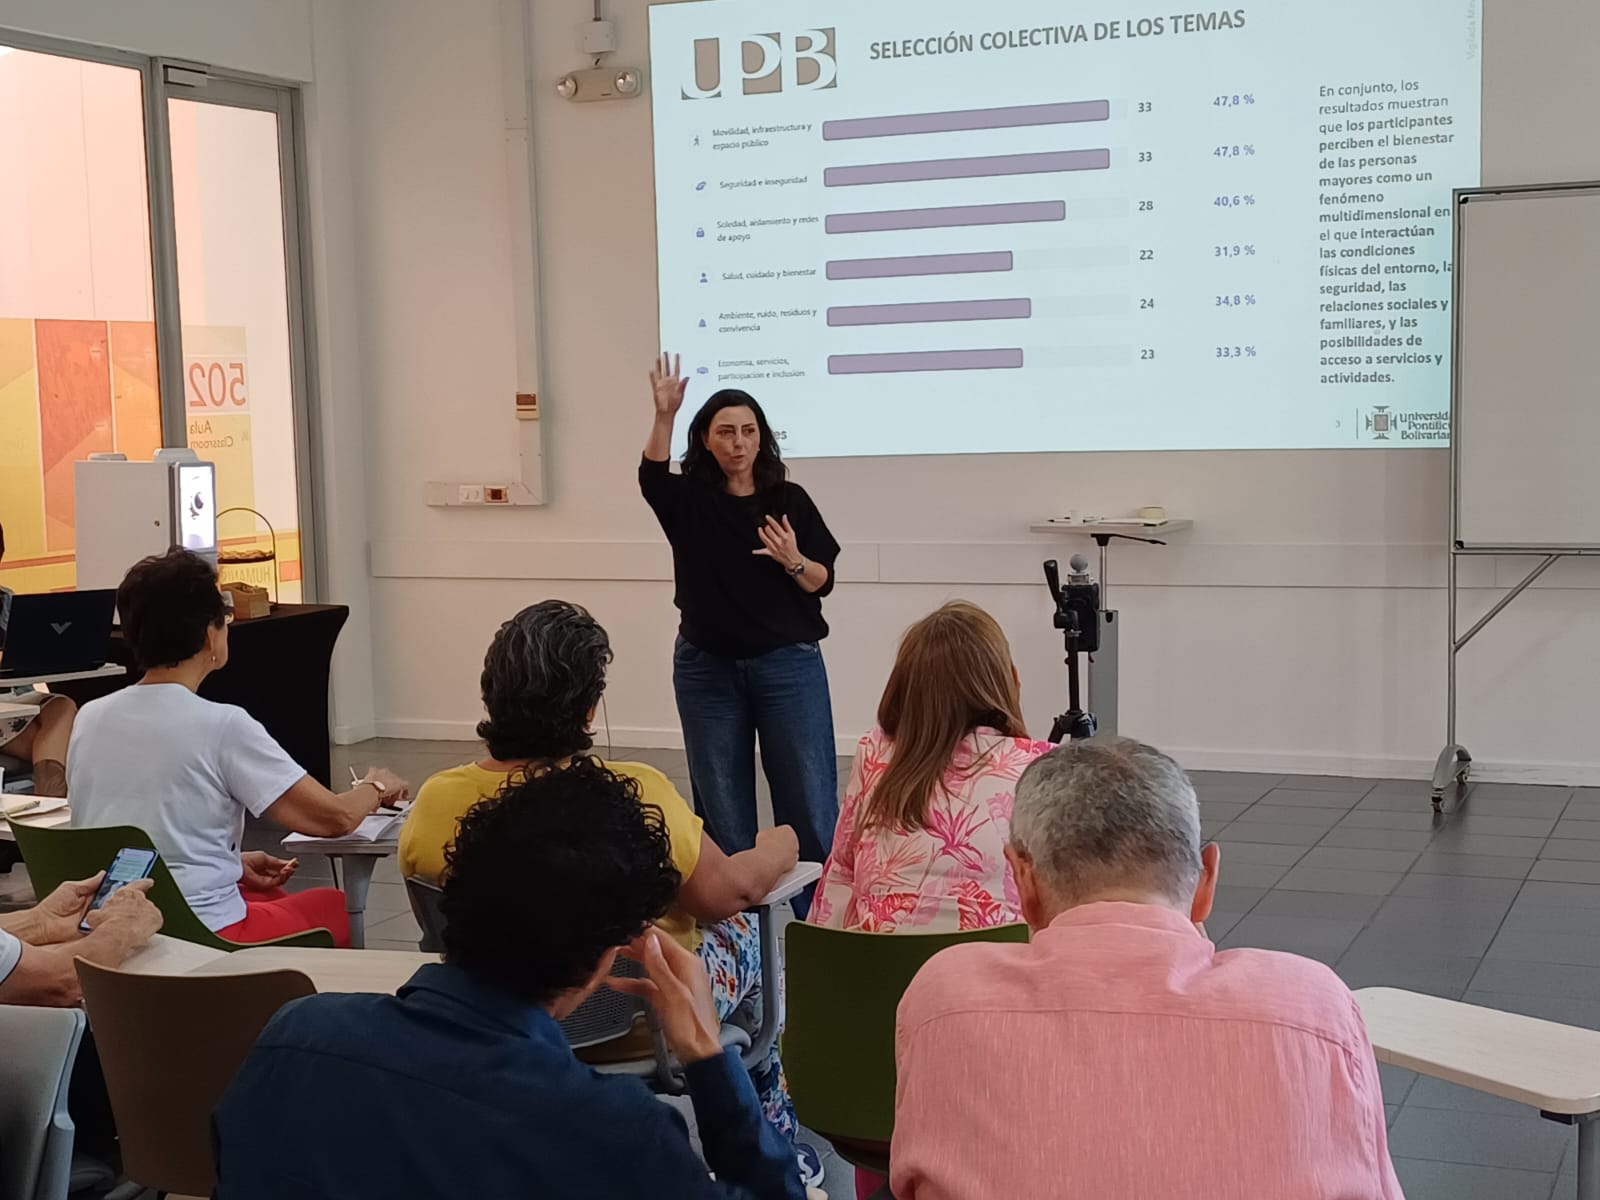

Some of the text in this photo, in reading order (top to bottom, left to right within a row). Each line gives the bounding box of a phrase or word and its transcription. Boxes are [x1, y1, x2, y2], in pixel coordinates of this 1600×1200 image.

[870, 9, 1245, 60] SELECCIÓN COLECTIVA DE LOS TEMAS
[681, 27, 838, 100] UPB
[1319, 80, 1419, 97] En conjunto, los
[1138, 102, 1152, 113] 33
[1213, 94, 1255, 108] 47,8 %
[1319, 97, 1449, 115] resultados muestran
[1319, 115, 1453, 135] que los participantes
[1319, 133, 1455, 153] perciben el bienestar
[1138, 151, 1152, 162] 33
[1213, 144, 1255, 158] 47,8 %
[1319, 154, 1417, 170] de las personas
[720, 179, 757, 190] Seguridad
[764, 176, 808, 187] inseguridad
[1319, 171, 1433, 188] mayores como un
[1138, 200, 1154, 211] 28
[1213, 194, 1255, 208] 40,6 %
[1319, 192, 1384, 205] fenómeno
[1319, 206, 1451, 223] multidimensional en
[717, 233, 751, 242] de apoyo
[1319, 225, 1435, 242] el que interactúan
[1139, 249, 1154, 260] 22
[1215, 244, 1256, 258] 31,9 %
[1319, 245, 1415, 259] las condiciones
[746, 270, 775, 279] cuidado
[782, 268, 816, 277] bienestar
[1319, 265, 1357, 276] físicas
[1361, 263, 1381, 275] del
[1384, 263, 1439, 275] entorno,
[1319, 281, 1407, 296] seguridad, las
[1140, 298, 1154, 309] 24
[1215, 294, 1256, 307] 34,8 %
[1320, 298, 1449, 312] relaciones sociales y
[780, 309, 811, 317] residuos
[1320, 317, 1418, 330] familiares, y las
[1320, 334, 1423, 350] posibilidades de
[1140, 349, 1155, 360] 23
[1215, 345, 1257, 358] 33,3 %
[1320, 352, 1443, 366] acceso a servicios y
[1320, 371, 1395, 384] actividades.
[1400, 411, 1448, 422] Universid
